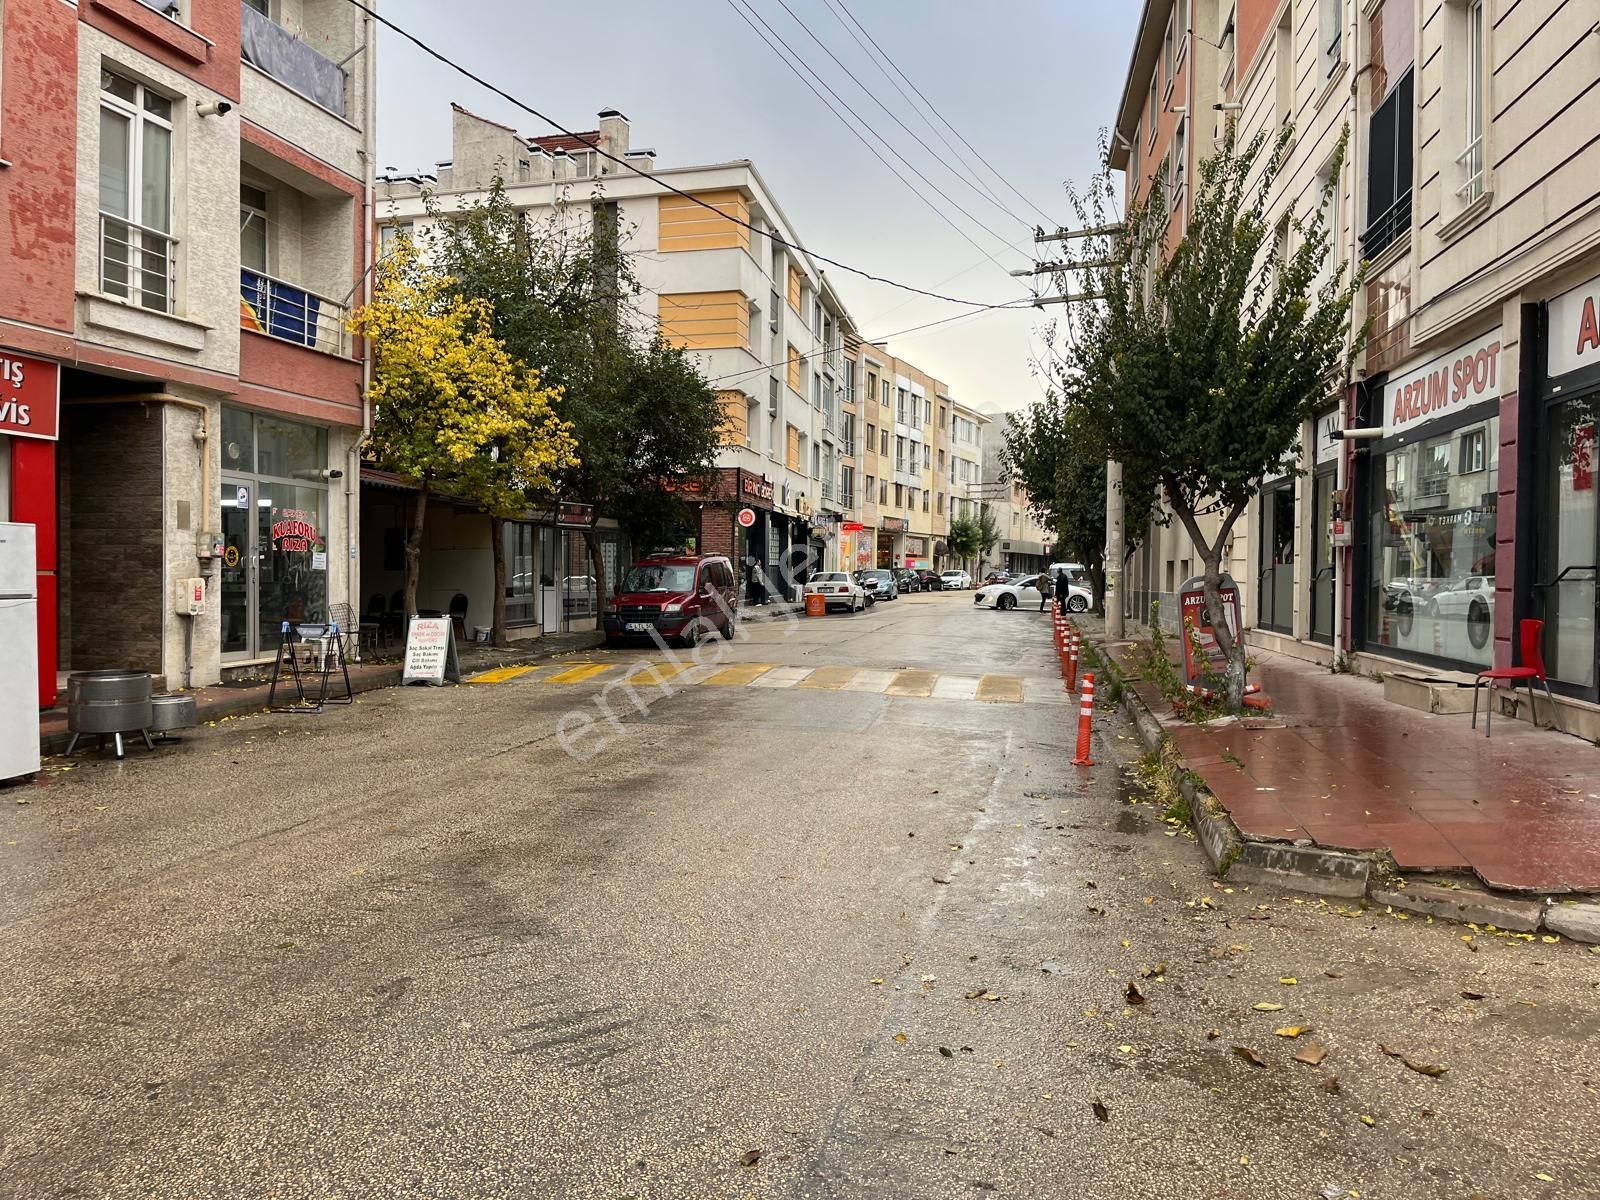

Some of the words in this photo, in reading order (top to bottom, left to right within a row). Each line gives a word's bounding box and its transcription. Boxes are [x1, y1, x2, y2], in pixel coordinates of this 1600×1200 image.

[0, 358, 24, 388] IŞ
[1393, 366, 1449, 427] ARZUM
[1452, 341, 1500, 403] SPOT
[1184, 595, 1206, 605] ARZU
